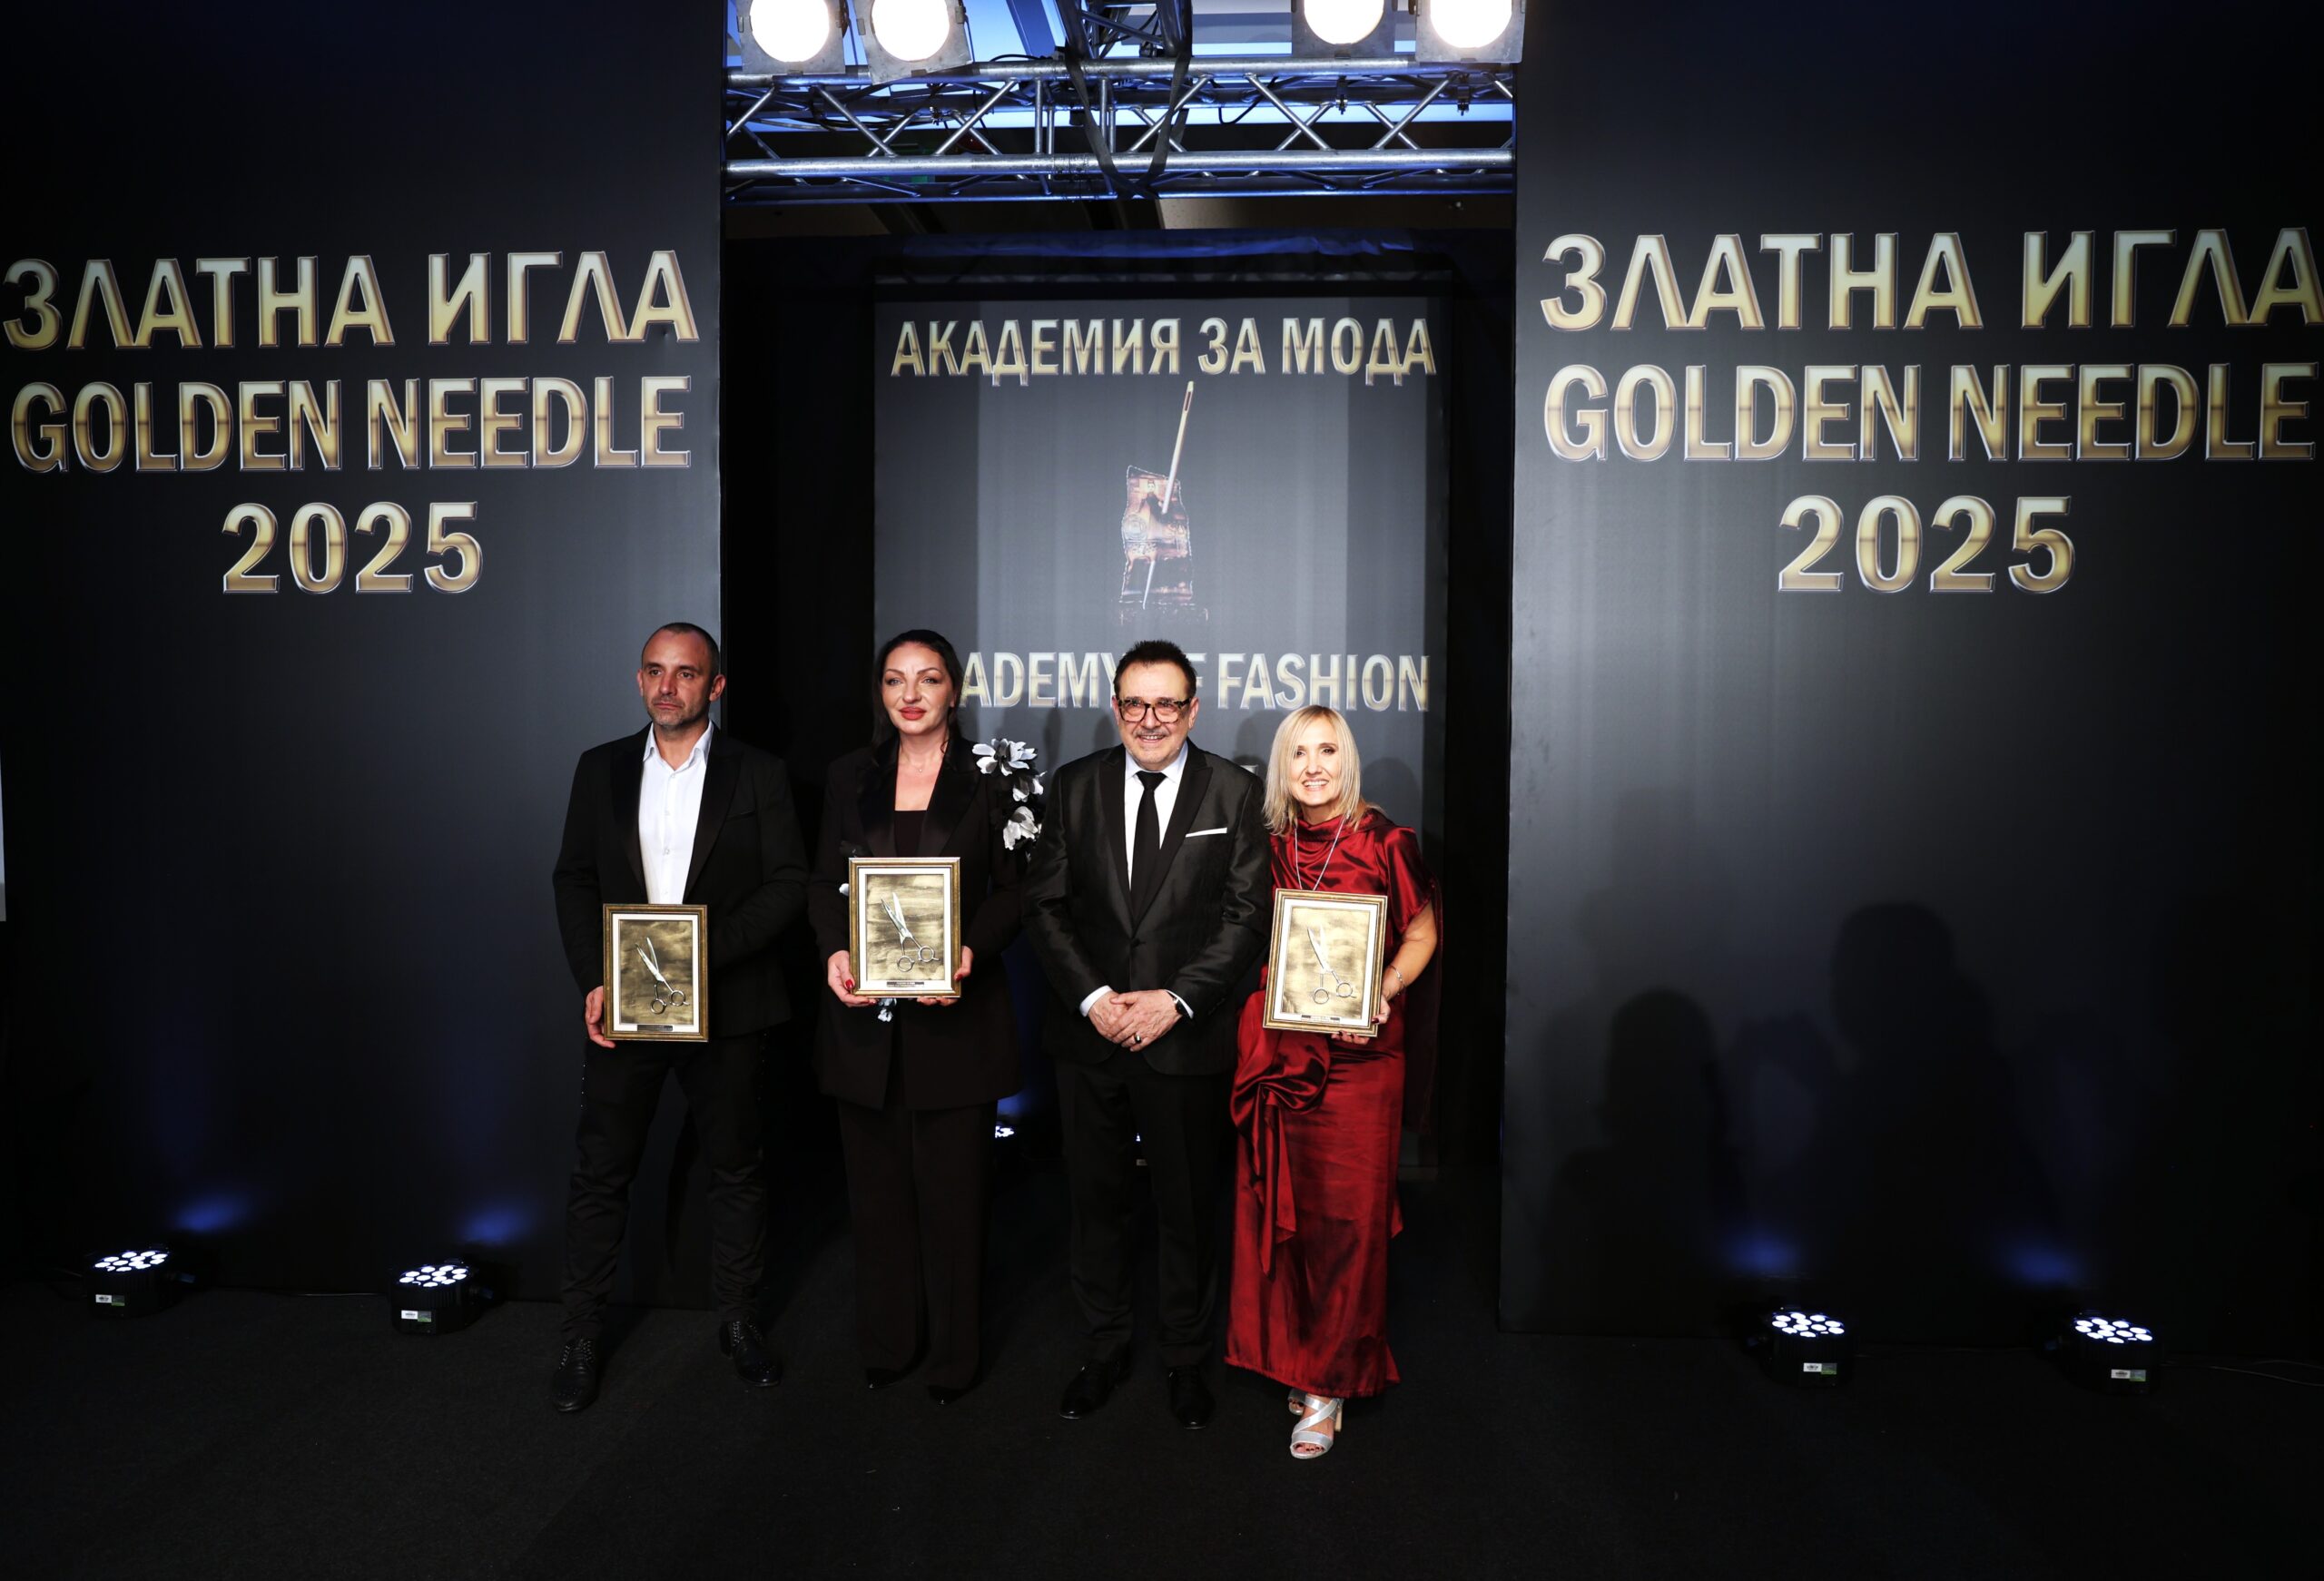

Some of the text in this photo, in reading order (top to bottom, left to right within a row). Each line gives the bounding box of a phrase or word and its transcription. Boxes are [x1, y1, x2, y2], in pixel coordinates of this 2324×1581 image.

[2, 250, 701, 350] ЗЛАТНА ИГЛА
[1540, 227, 2324, 332] ЗЛАТНА ИГЛА
[891, 317, 1437, 386] АКАДЕМИЯ ЗА МОДА
[11, 376, 692, 473] GOLDEN NEEDLE
[1543, 362, 2318, 462] GOLDEN NEEDLE
[222, 500, 483, 594] 2025
[1777, 495, 2076, 594] 2025
[957, 652, 1126, 709] ADEMY
[1217, 653, 1430, 712] FASHION
